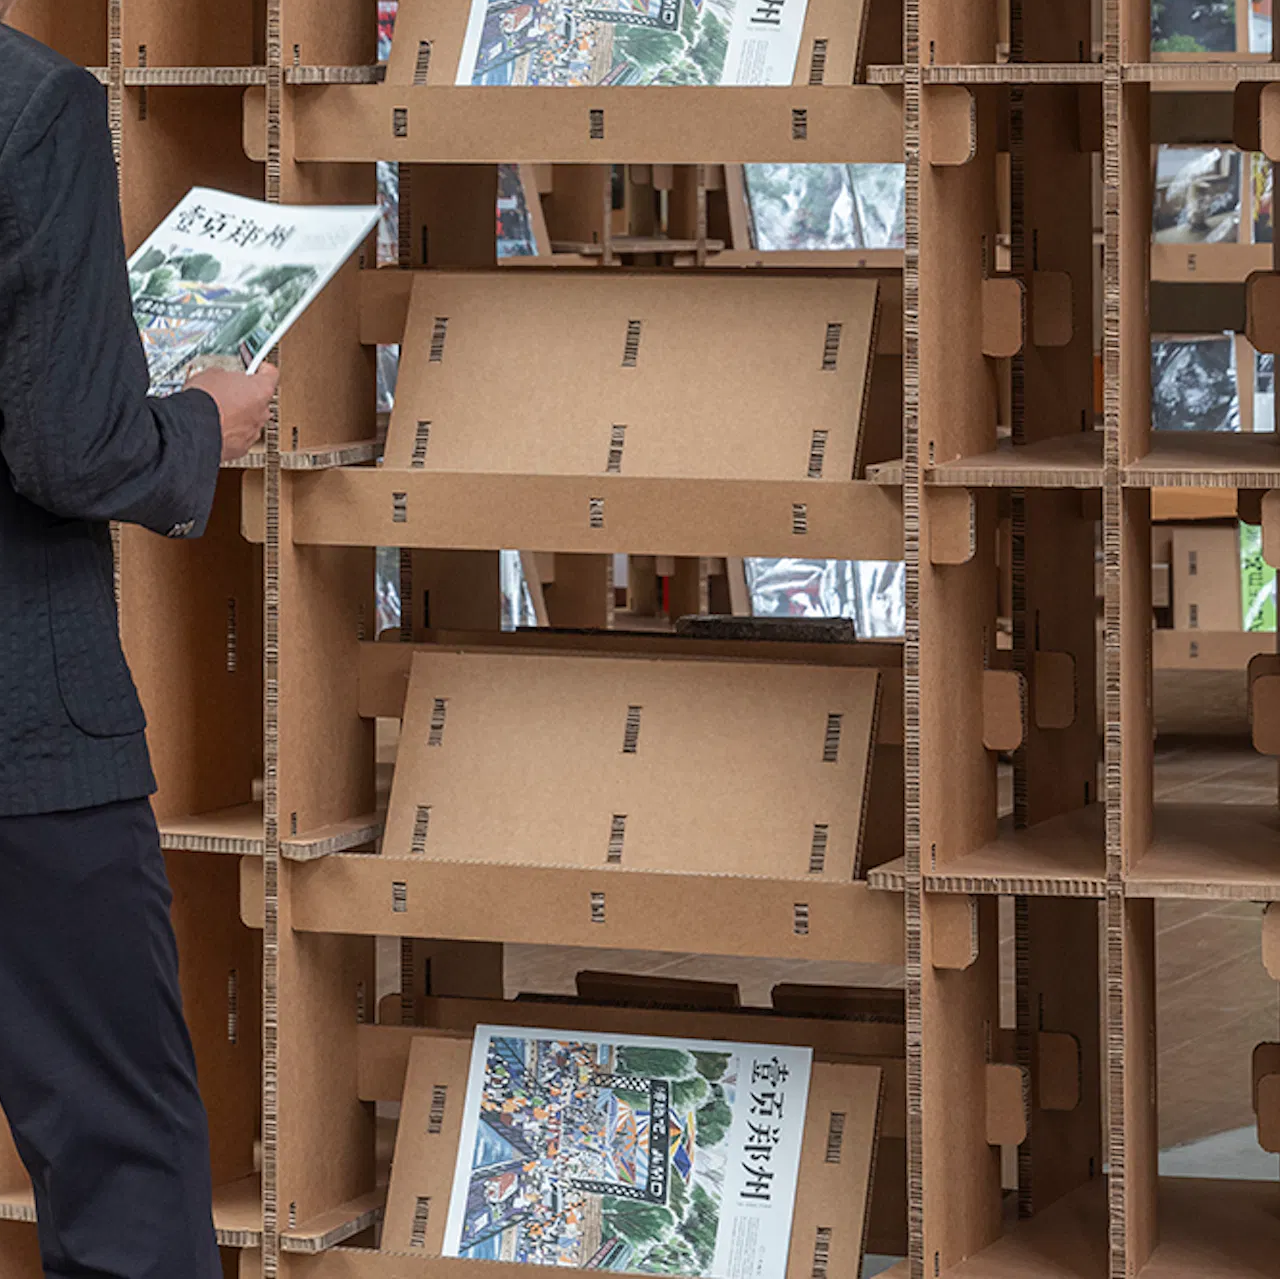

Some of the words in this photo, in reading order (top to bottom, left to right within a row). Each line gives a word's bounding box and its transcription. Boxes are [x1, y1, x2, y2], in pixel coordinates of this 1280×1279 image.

[171, 204, 296, 249] 壹页郑州
[740, 1056, 790, 1202] 壹页郑州
